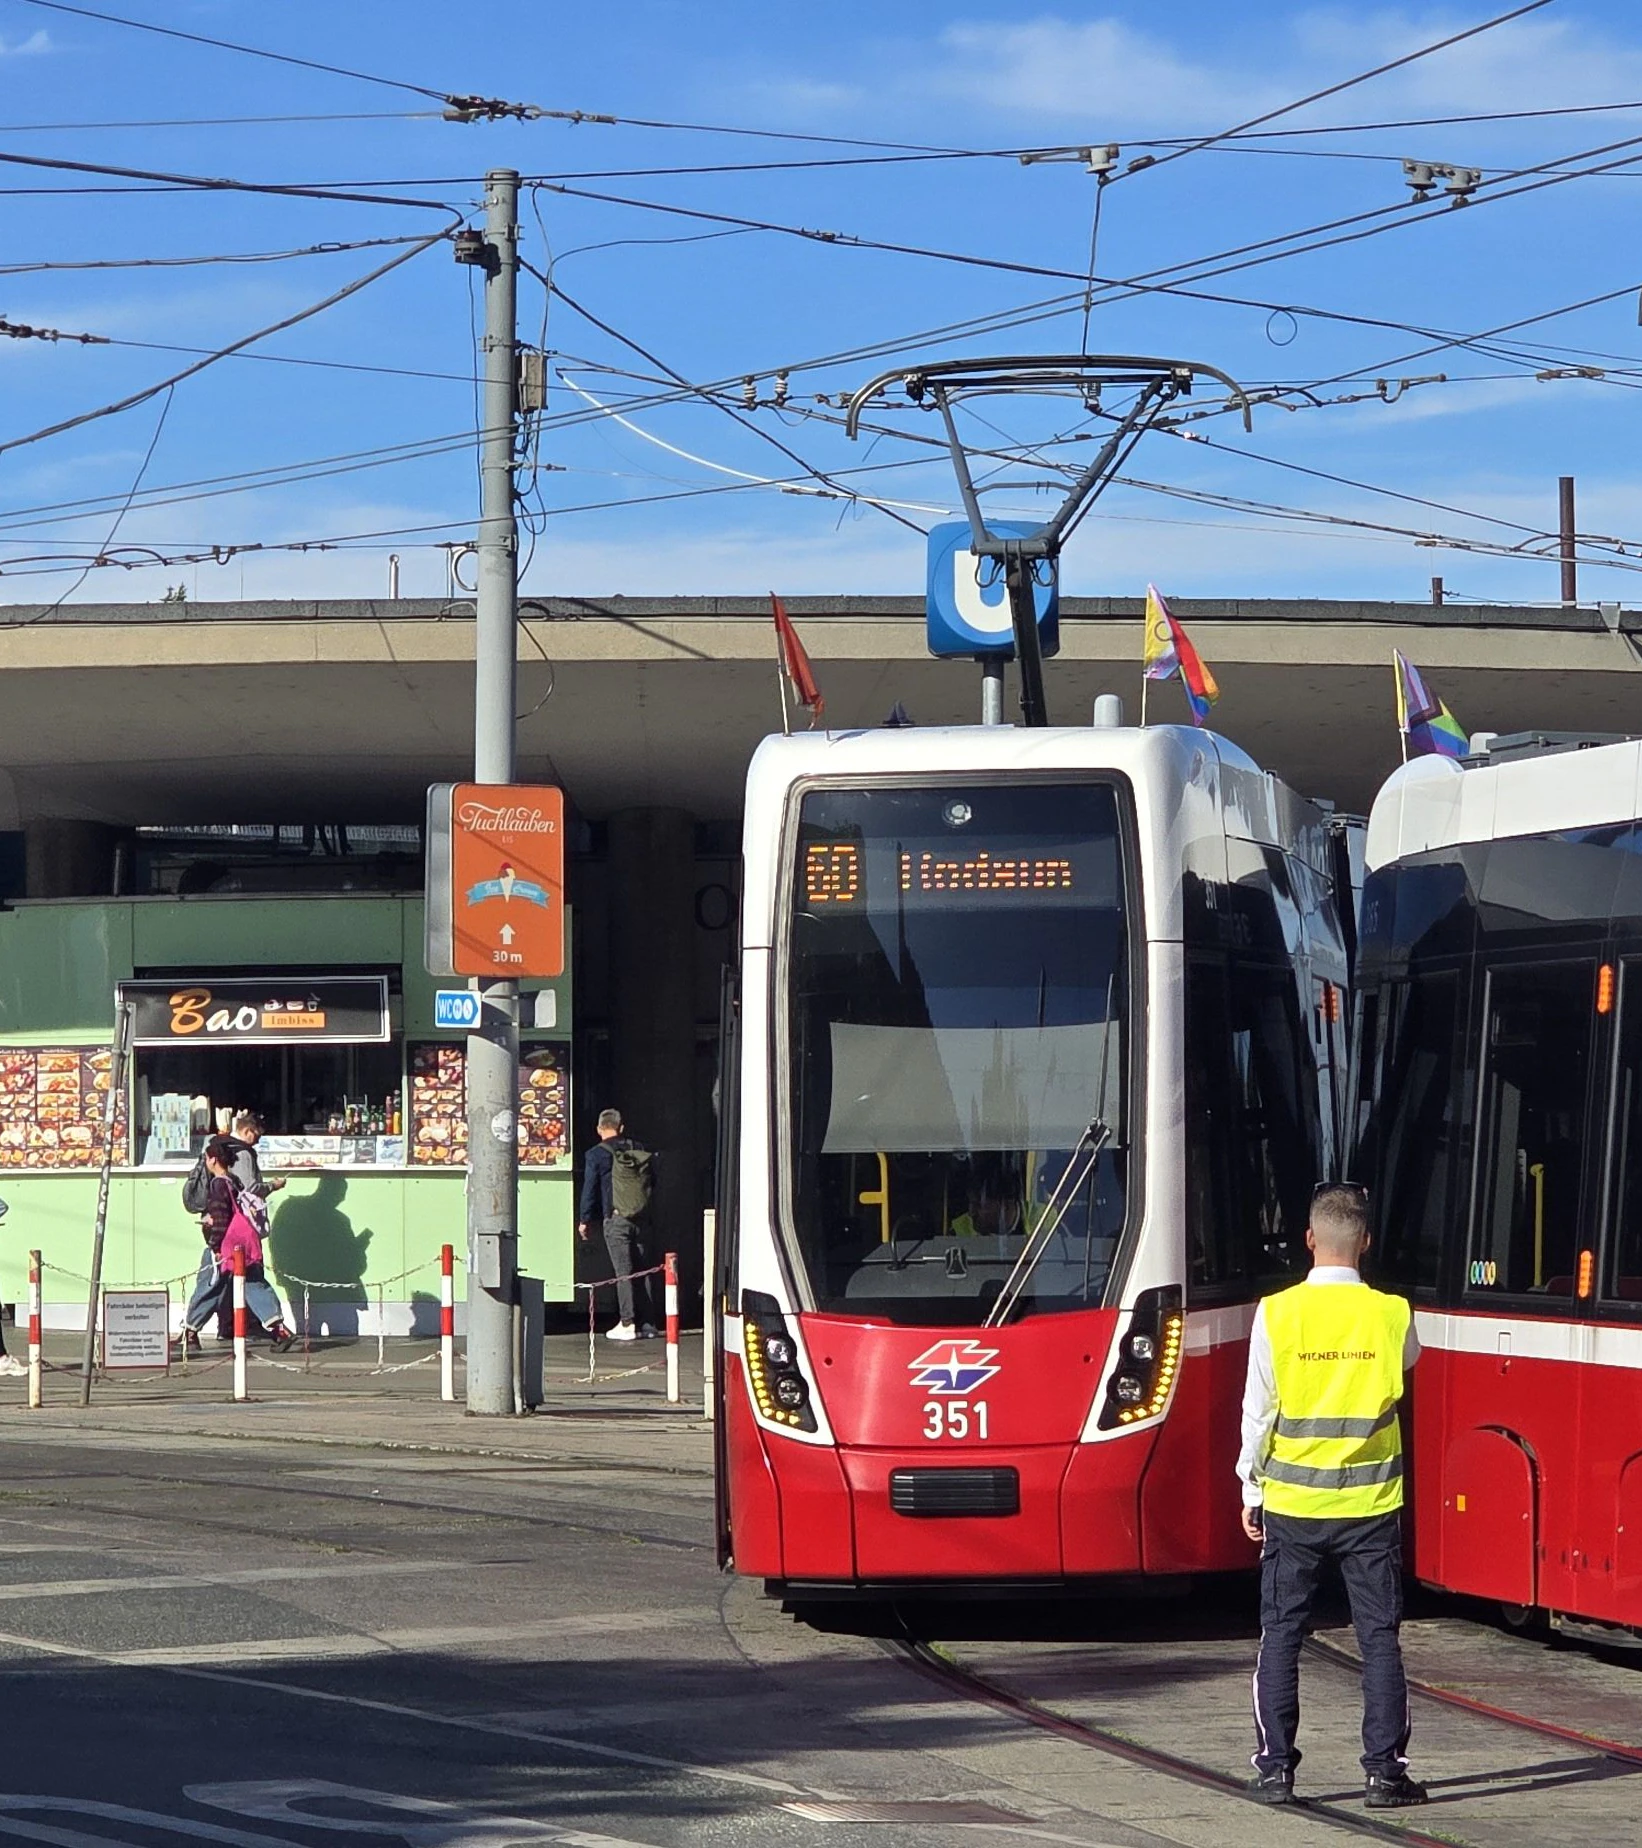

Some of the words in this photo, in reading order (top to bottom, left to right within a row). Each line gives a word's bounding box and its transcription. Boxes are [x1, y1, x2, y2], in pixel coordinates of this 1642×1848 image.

[459, 802, 556, 833] Tuchlauben
[492, 950, 508, 963] 30
[510, 953, 523, 963] m
[168, 988, 258, 1034] Bao
[271, 1014, 315, 1026] Imbiss
[437, 998, 453, 1019] WC
[1298, 1351, 1340, 1361] WIENER
[1341, 1350, 1376, 1360] LINIEN
[923, 1400, 988, 1440] 351
